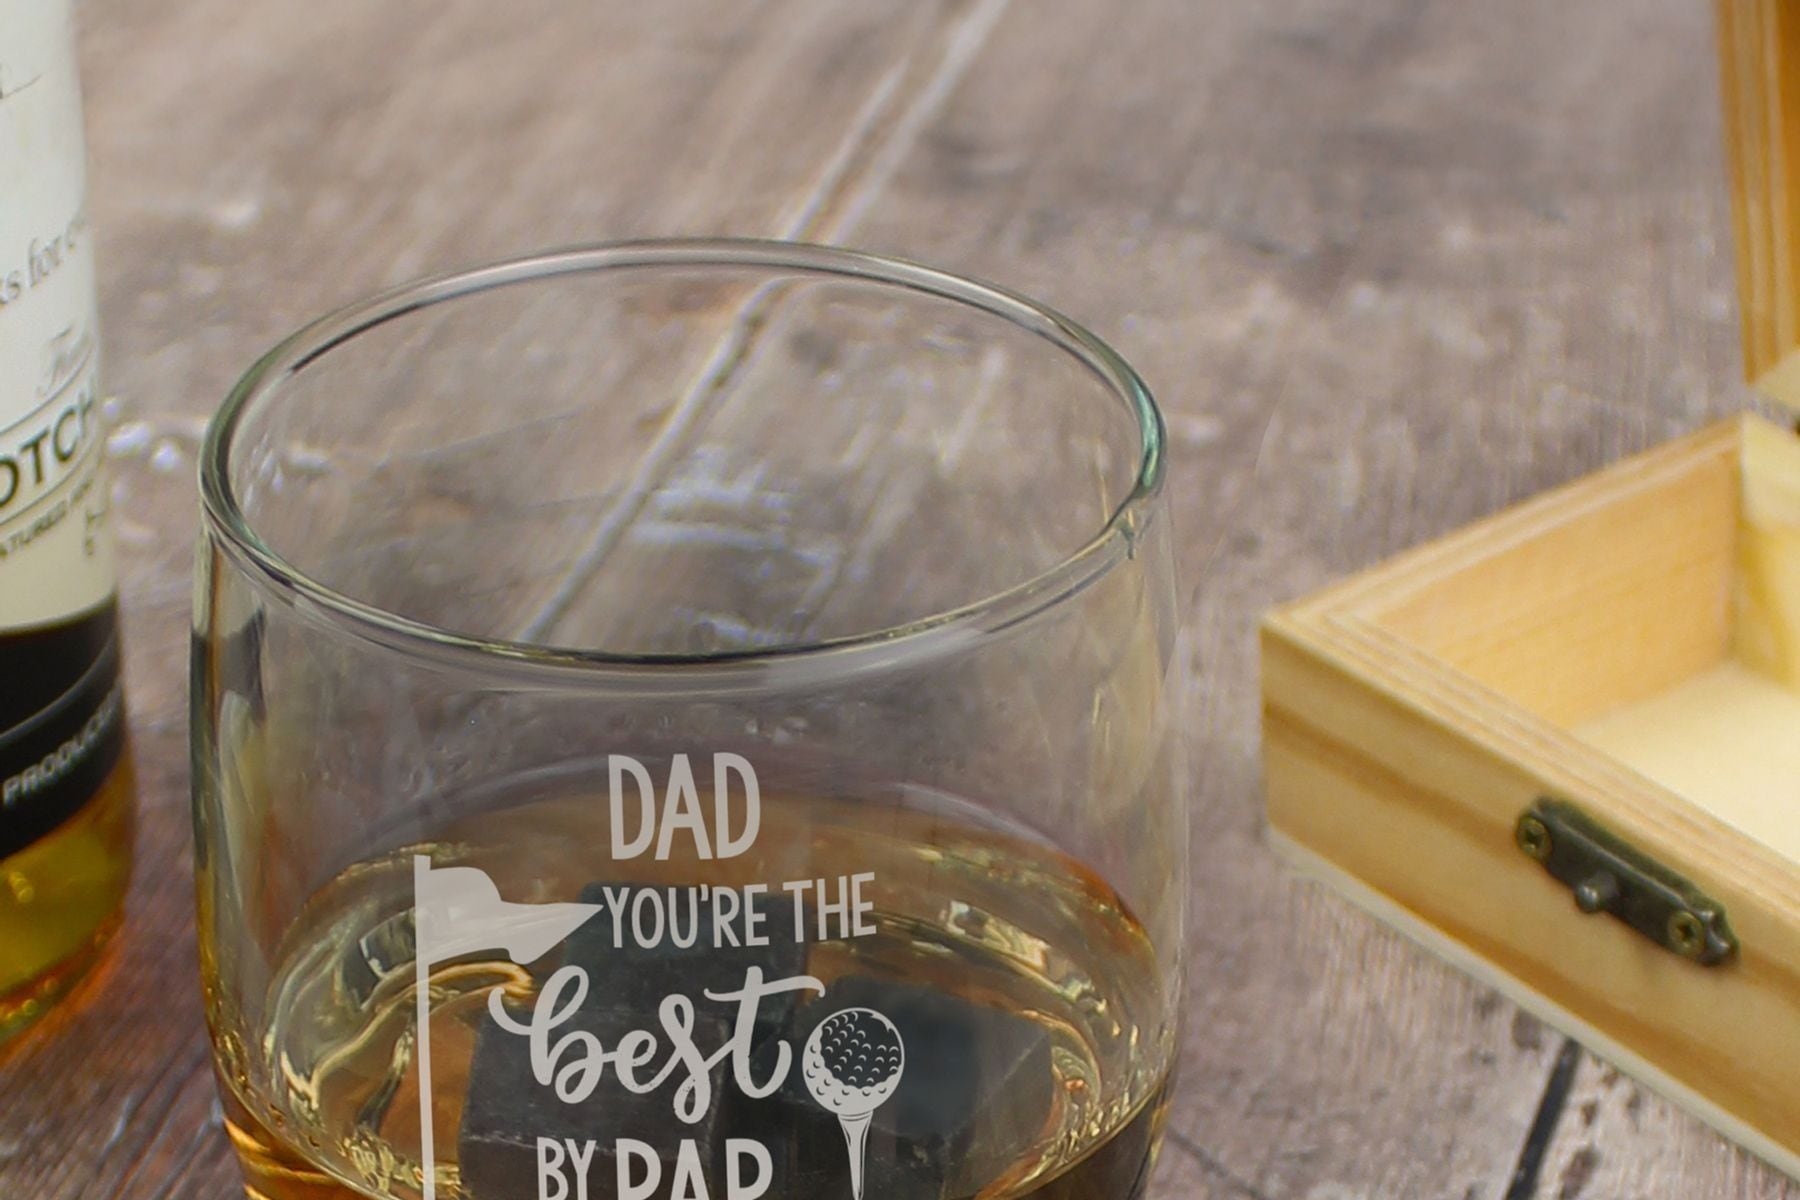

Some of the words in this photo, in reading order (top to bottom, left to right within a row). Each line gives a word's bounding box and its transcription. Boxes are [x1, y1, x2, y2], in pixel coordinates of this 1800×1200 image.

[608, 752, 760, 860] DAD
[603, 884, 769, 949] YOU'RE
[783, 872, 877, 943] THE
[488, 964, 826, 1124] best
